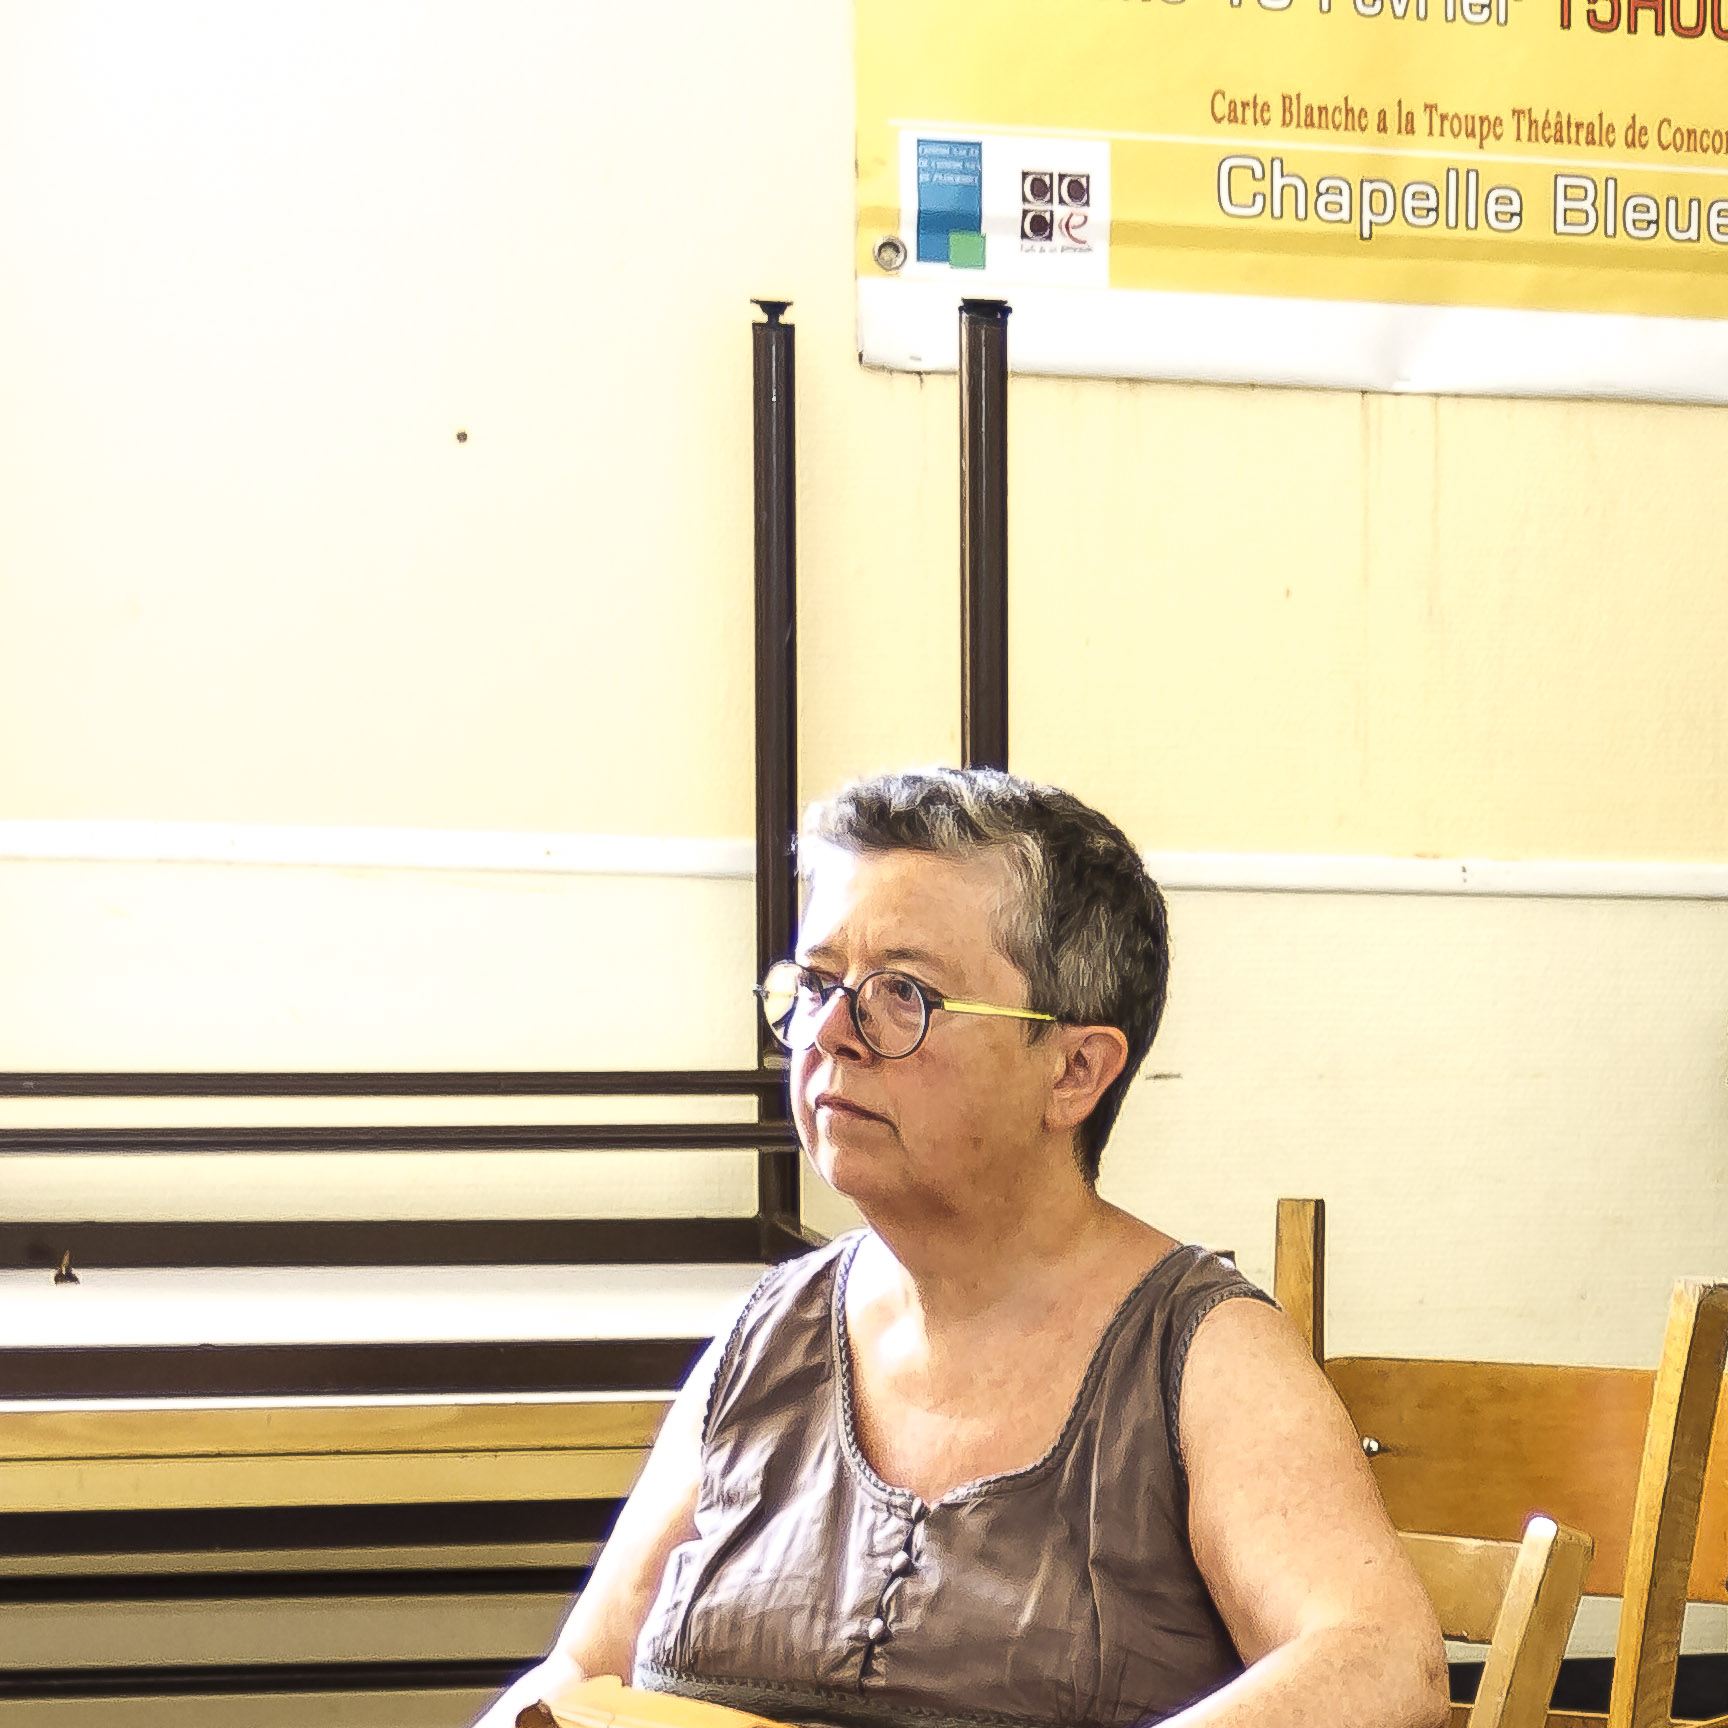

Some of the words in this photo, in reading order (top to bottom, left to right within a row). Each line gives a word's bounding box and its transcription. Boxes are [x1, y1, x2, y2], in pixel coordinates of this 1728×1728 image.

[1210, 89, 1271, 127] Carte
[1281, 91, 1369, 134] Blanche
[1377, 108, 1388, 134] a
[1397, 98, 1415, 136] la
[1424, 101, 1504, 150] Troupe
[1511, 107, 1616, 148] Théâtrale
[1625, 113, 1649, 149] de
[1217, 154, 1523, 240] Chapelle
